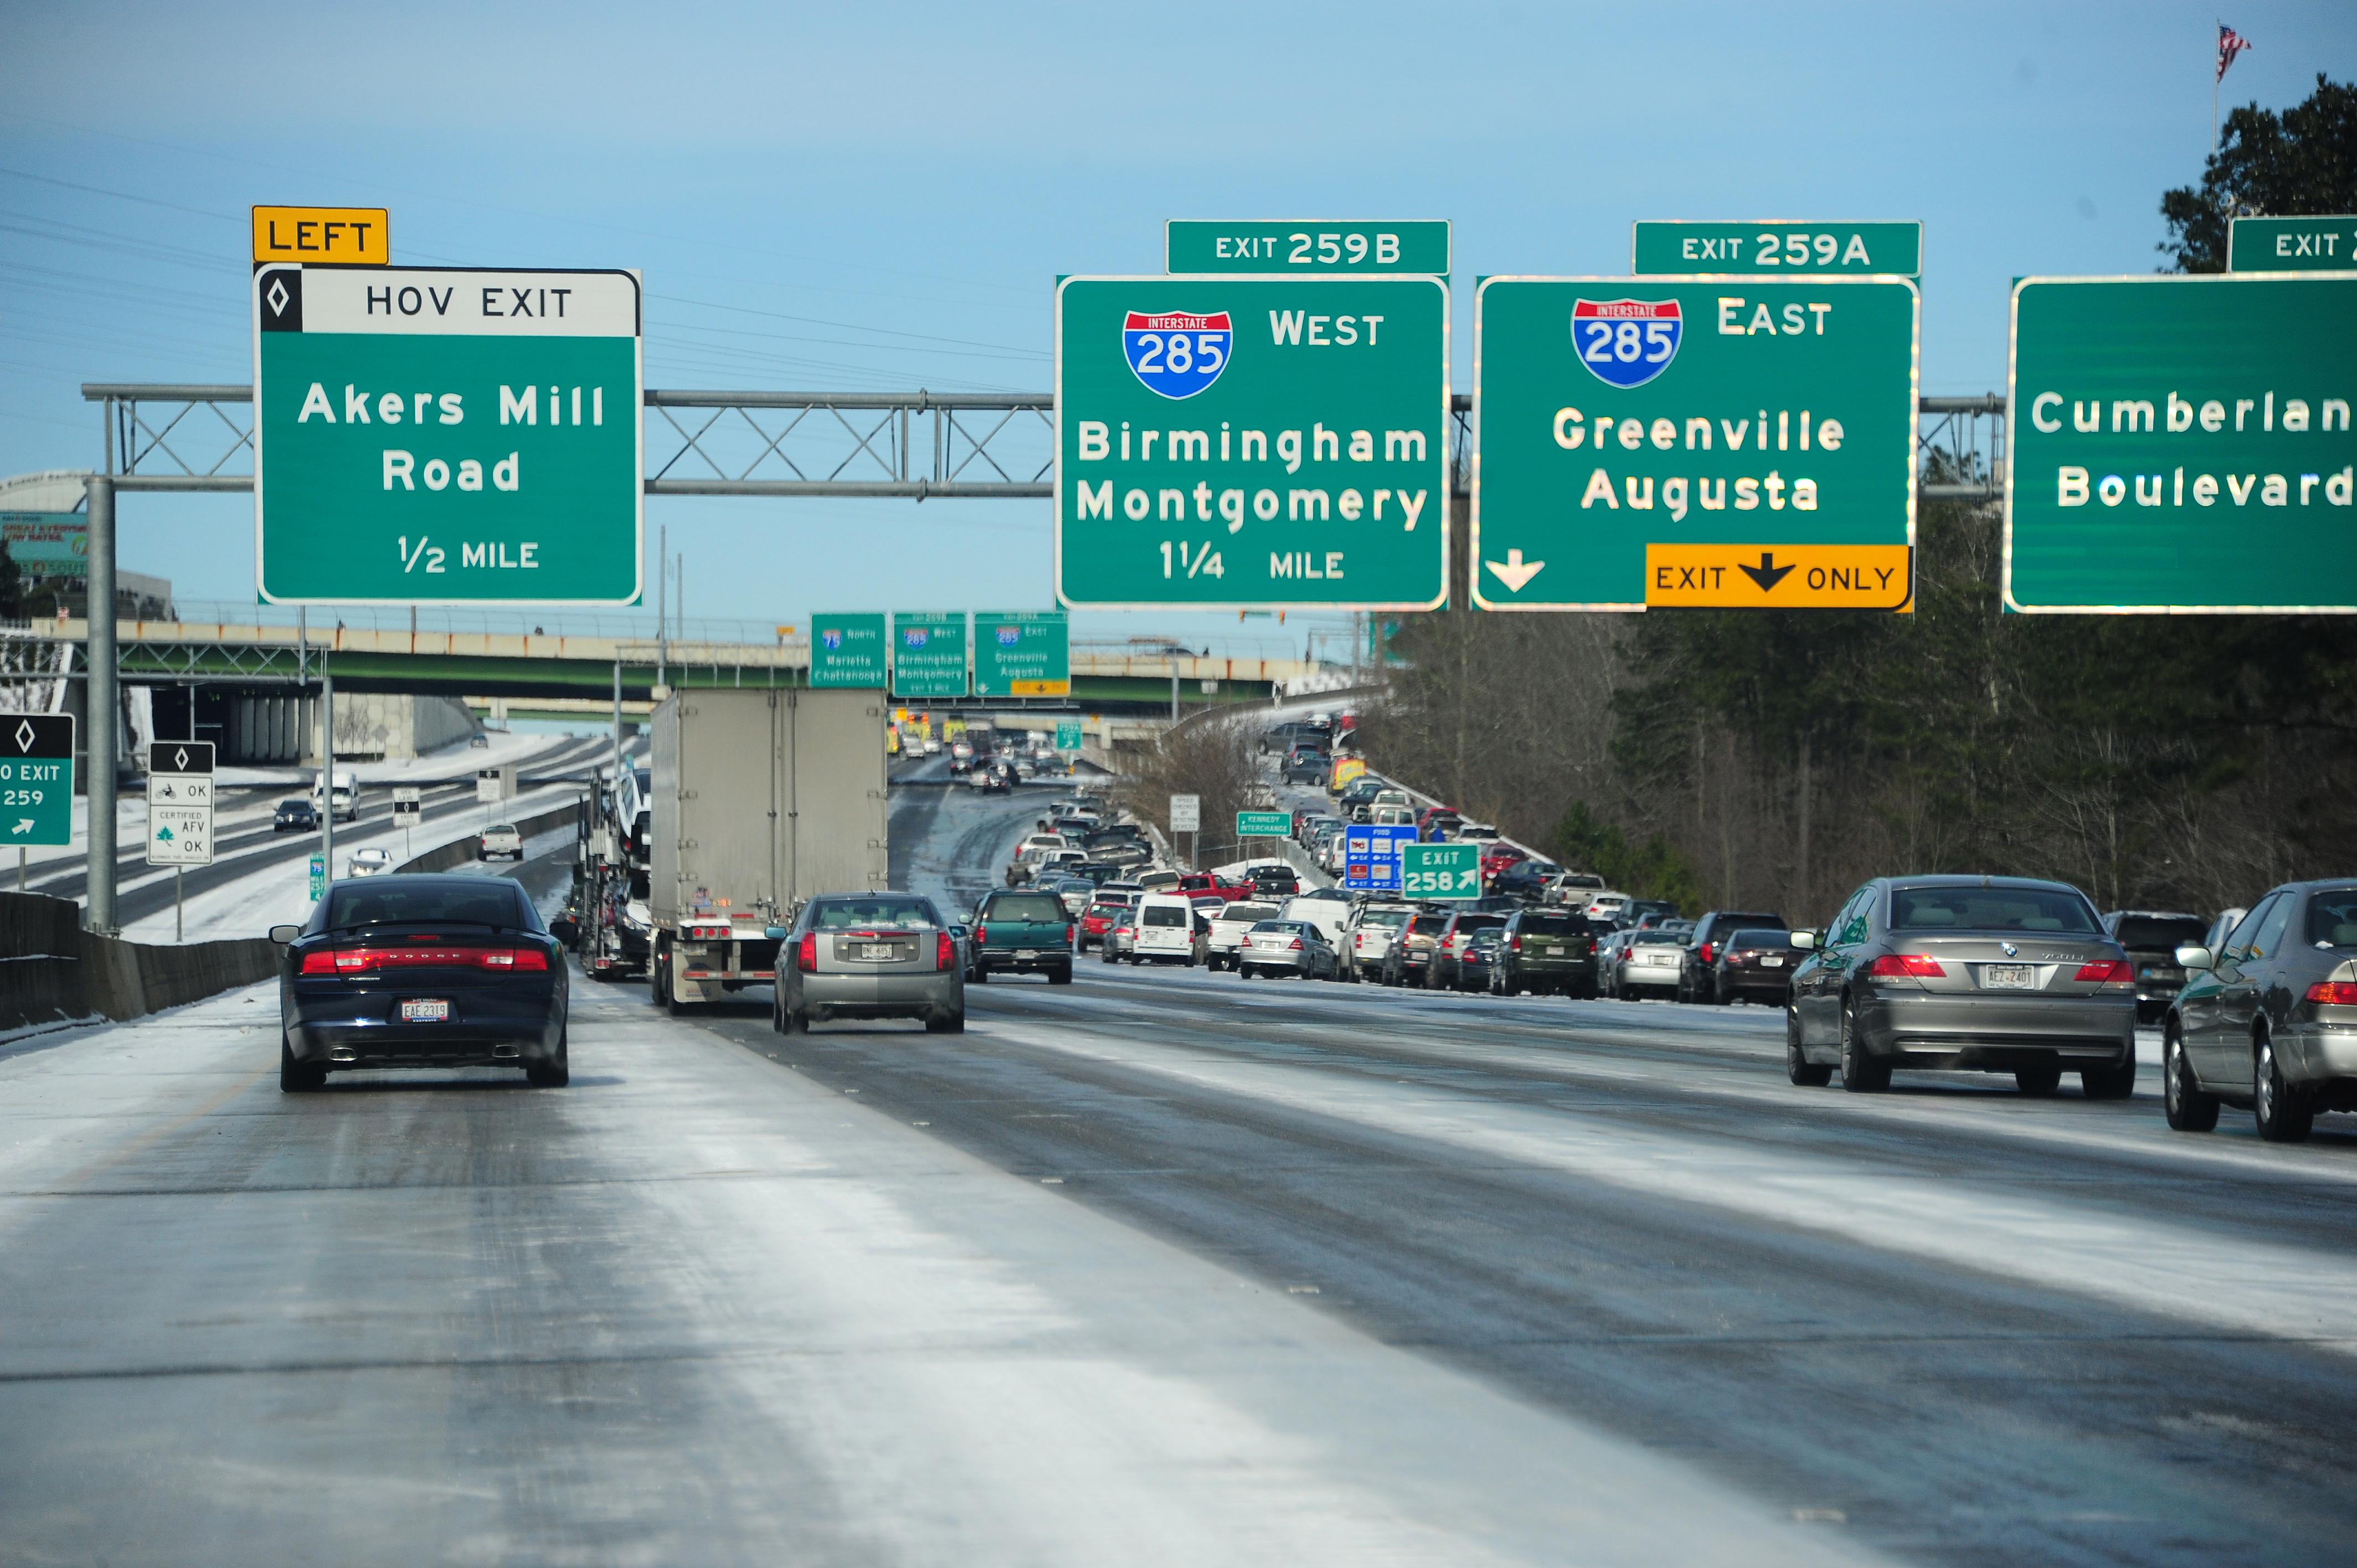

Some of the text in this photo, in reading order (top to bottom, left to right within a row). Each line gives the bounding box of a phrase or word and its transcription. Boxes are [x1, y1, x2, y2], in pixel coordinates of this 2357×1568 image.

[269, 220, 372, 251] LEFT
[2276, 233, 2340, 256] EXIT
[1216, 233, 1401, 264] EXIT 259B
[1682, 234, 1871, 266] EXIT 259A
[367, 286, 572, 317] HOV EXIT
[1597, 305, 1658, 317] INTERSTATE
[1717, 297, 1832, 336] EAST
[1147, 317, 1208, 329] INTERSTATE
[1269, 310, 1385, 346] WEST
[1584, 321, 1673, 363] 285
[1137, 334, 1224, 374] 285
[297, 382, 603, 426] Akers Mill
[1553, 406, 1845, 451] Greenville
[1078, 420, 1427, 475] Birmingham
[383, 450, 519, 492] Road
[2057, 465, 2354, 507] Boulevard
[1580, 468, 1819, 523] Augusta
[1077, 479, 1428, 535] Montgomery
[462, 541, 539, 569] MILE
[1270, 552, 1344, 579] MILE
[1657, 568, 1895, 591] EXIT ONLY
[907, 635, 927, 645] 285
[934, 627, 956, 638] WEST
[999, 633, 1018, 643] 285
[1026, 626, 1047, 636] EAST
[827, 654, 871, 667] Marietta
[898, 653, 962, 668] Birmingham
[996, 652, 1047, 663] Greenville
[815, 669, 882, 683] Chattanooga
[898, 668, 962, 682] Montgomery
[1001, 667, 1044, 679] Augusta
[21, 765, 60, 781] EXIT
[4, 790, 43, 805] 259
[188, 786, 206, 797] OK
[183, 822, 204, 832] AFV
[184, 841, 202, 852] OK
[1422, 852, 1459, 865] EXIT
[1406, 871, 1453, 891] 258
[1989, 971, 2031, 983] AEZ 2401
[405, 1005, 445, 1017] EAE 2319
